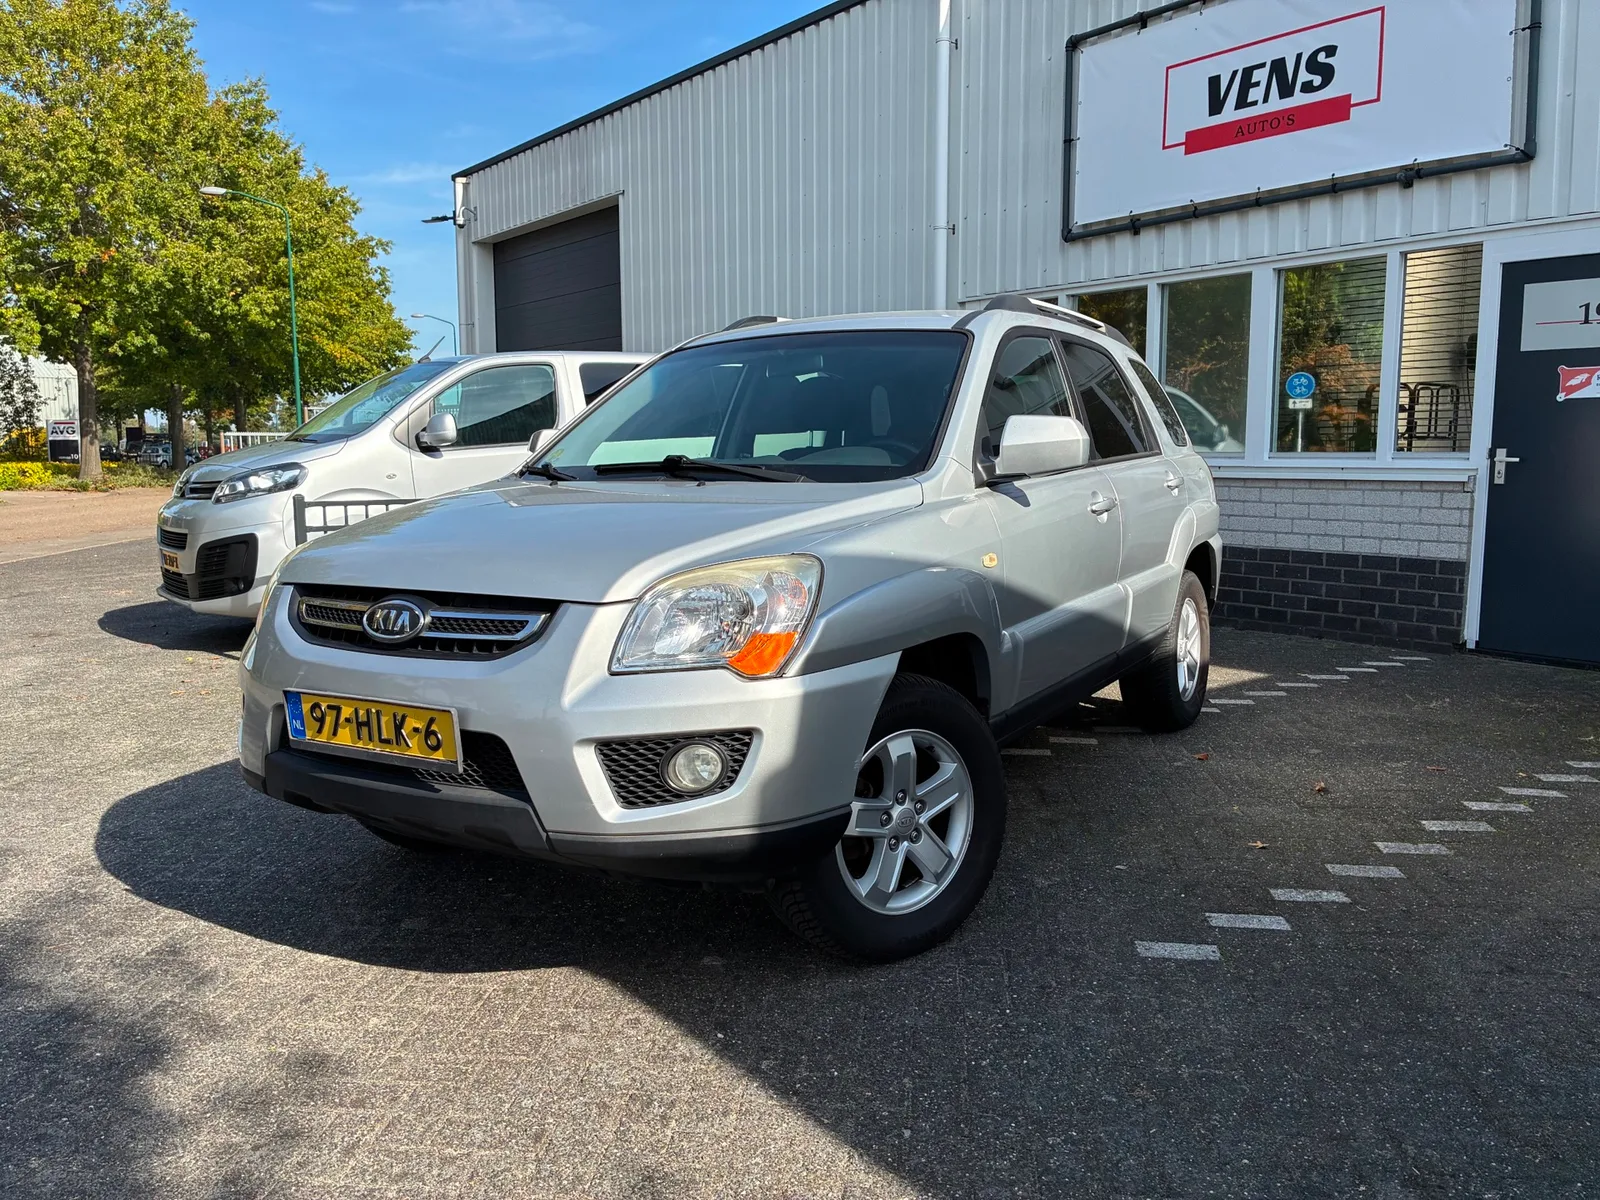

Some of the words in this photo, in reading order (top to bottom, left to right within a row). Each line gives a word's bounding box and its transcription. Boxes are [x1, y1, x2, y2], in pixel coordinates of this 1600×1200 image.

[1207, 44, 1339, 118] VENS
[1233, 113, 1296, 138] AUTO'S
[50, 425, 76, 435] AVG
[371, 608, 411, 633] KIA
[292, 718, 304, 730] NL
[309, 701, 443, 752] 97-HLK-6
